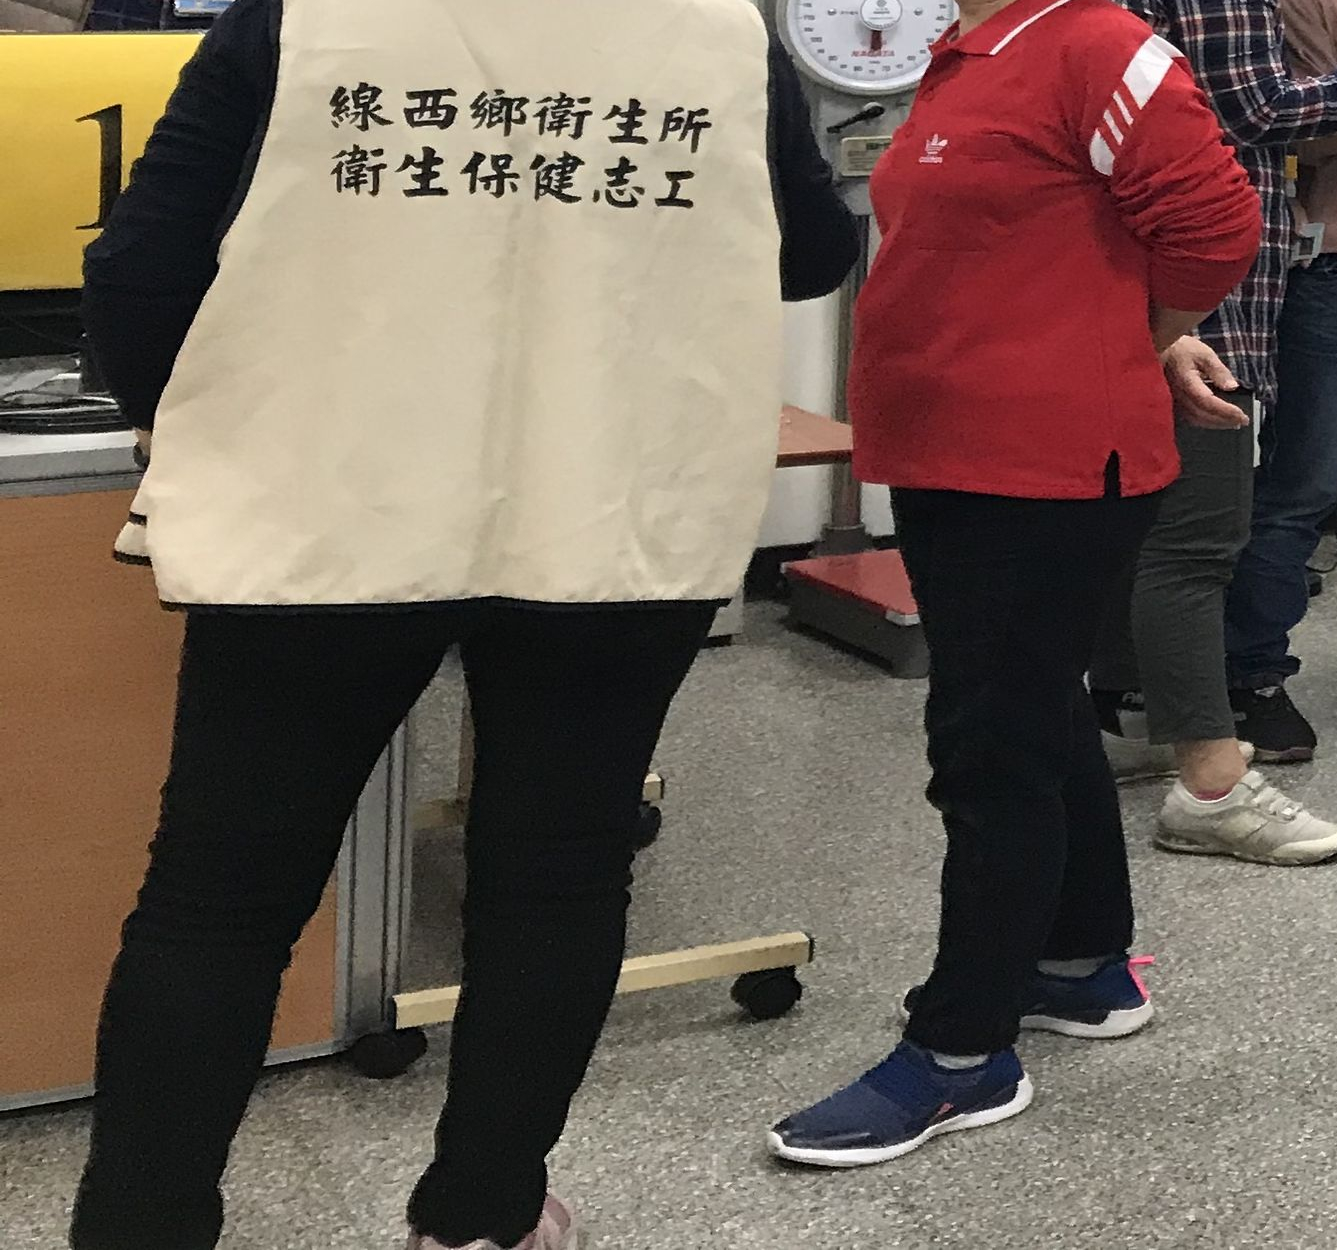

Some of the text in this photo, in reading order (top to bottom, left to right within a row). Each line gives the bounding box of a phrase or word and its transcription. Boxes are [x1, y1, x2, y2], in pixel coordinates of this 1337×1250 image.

[328, 82, 713, 154] 線西鄉衛生所
[75, 103, 124, 231] 1
[329, 149, 697, 210] 衛生保健志工
